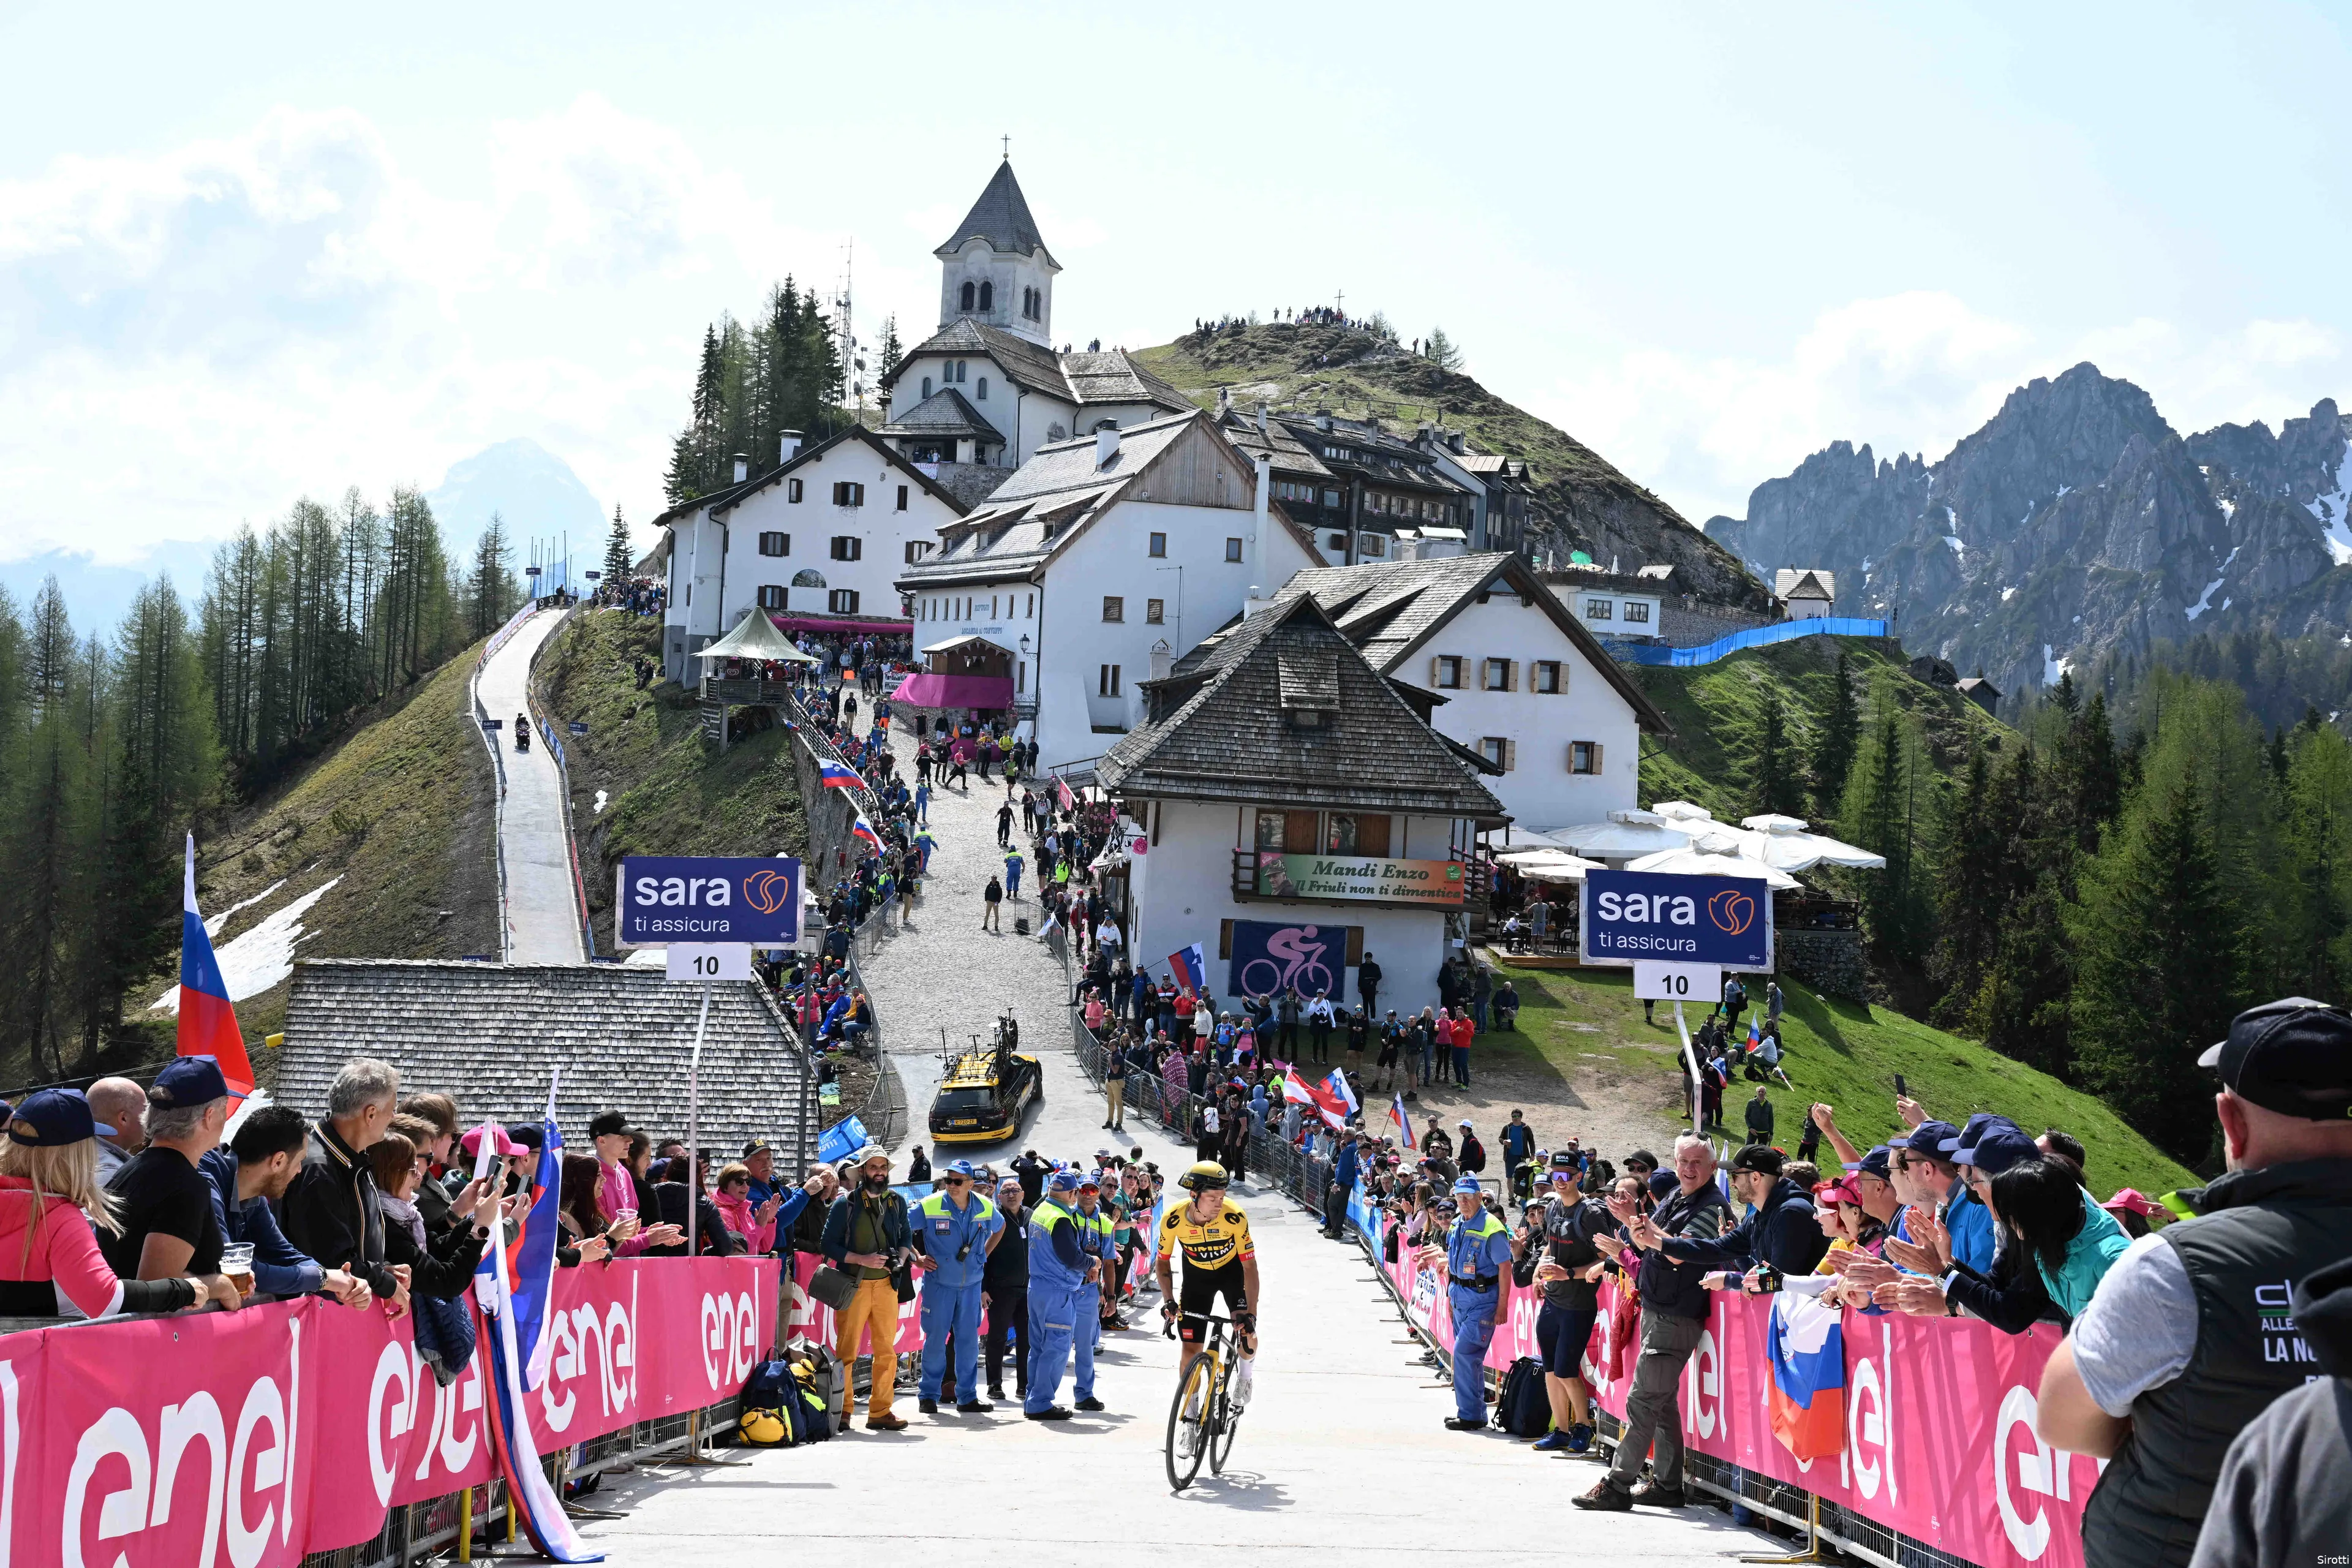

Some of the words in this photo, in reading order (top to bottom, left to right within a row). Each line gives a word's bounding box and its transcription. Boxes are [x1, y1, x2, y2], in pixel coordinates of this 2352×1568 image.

[1312, 861, 1378, 877] Mandi
[1381, 864, 1429, 880] Enzo
[635, 876, 731, 907] sara
[1294, 880, 1306, 891] Il
[1307, 880, 1347, 893] Friuli
[1349, 885, 1375, 894] non
[1379, 884, 1390, 895] ti
[1392, 884, 1461, 899] dimentica
[1597, 891, 1695, 925] sara
[634, 916, 646, 931] ti
[652, 916, 730, 932] assicura
[1598, 932, 1611, 947] ti
[1616, 934, 1696, 952] assicura
[693, 956, 719, 975] 10
[1662, 974, 1689, 995] 10
[1183, 1238, 1232, 1252] JUMBO
[1200, 1242, 1234, 1259] VISMA
[1415, 1275, 1436, 1296] INTERISTA
[1415, 1299, 1431, 1316] MILAN
[701, 1266, 760, 1391] enel
[541, 1270, 637, 1433] enel
[2264, 1337, 2289, 1362] LA
[62, 1317, 300, 1568] enel
